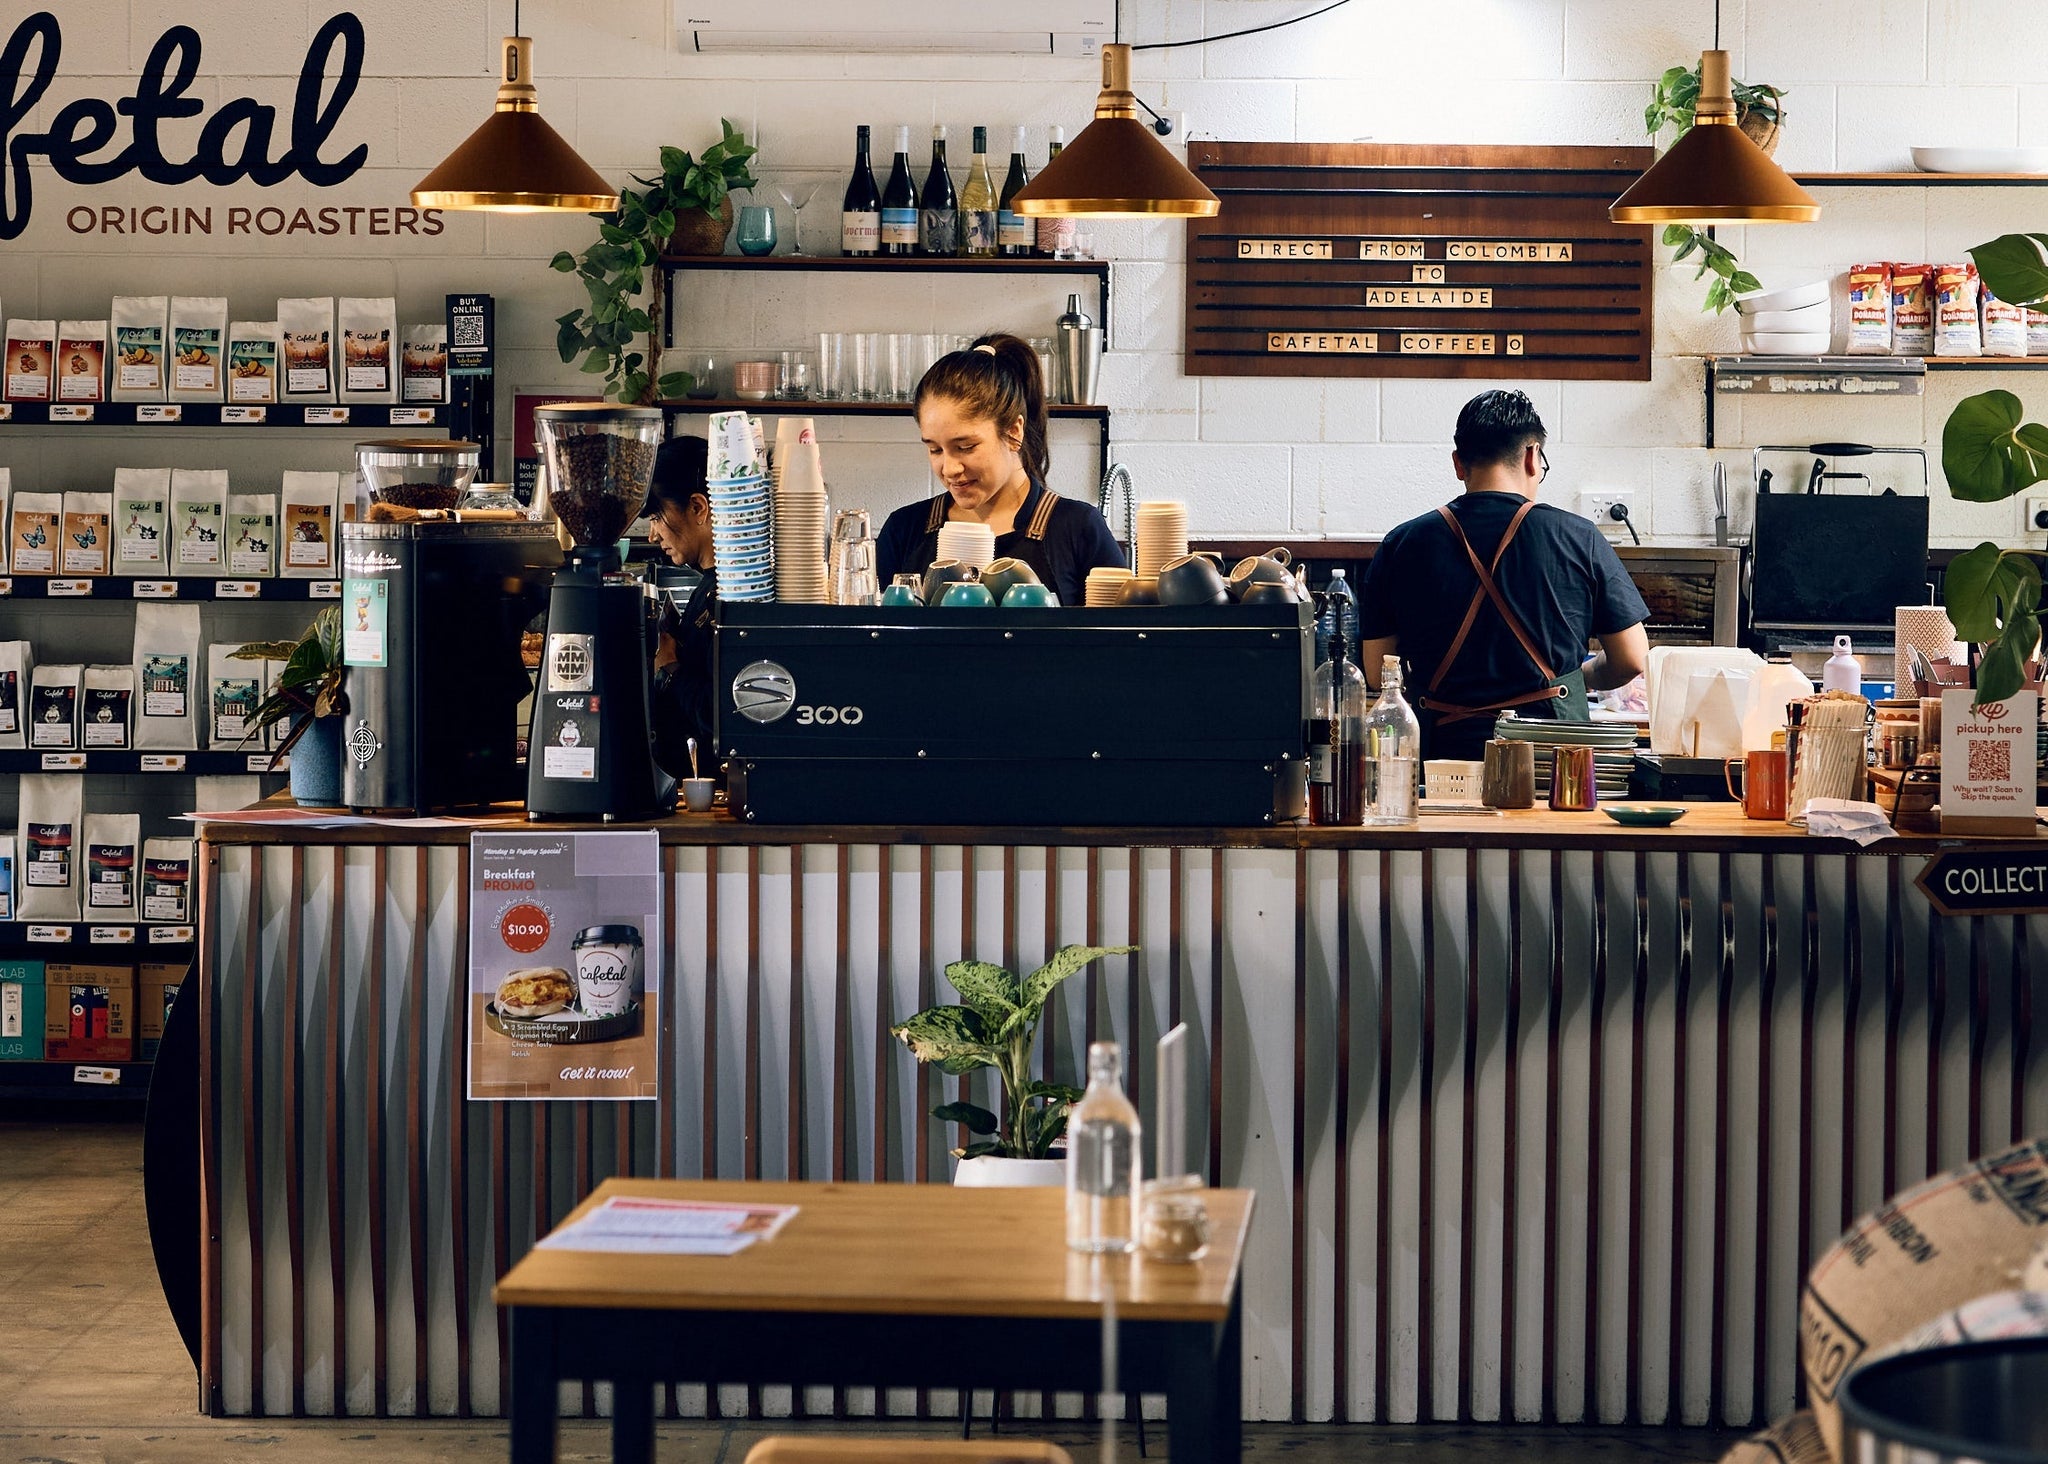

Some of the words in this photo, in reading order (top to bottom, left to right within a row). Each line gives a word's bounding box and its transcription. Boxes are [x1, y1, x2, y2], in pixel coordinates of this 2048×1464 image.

[67, 206, 211, 235] ORIGIN
[228, 206, 445, 236] ROASTERS
[1239, 242, 1331, 257] DIRECT
[1363, 242, 1425, 258] FROM
[1449, 243, 1570, 260] COLOMBIA
[1415, 266, 1443, 281] TO
[1368, 290, 1491, 305] ADELAIDE
[1270, 335, 1375, 350] CAFETAL
[1403, 336, 1492, 351] COFFEE
[556, 698, 585, 710] Cafetal
[796, 705, 864, 726] 300
[1956, 723, 1995, 736] pickup
[1997, 724, 2023, 734] here
[1952, 785, 1971, 794] Why
[1972, 785, 1993, 793] wait?
[1994, 785, 2014, 793] Scan
[1960, 793, 1978, 801] Skip
[1978, 793, 1991, 801] the
[1991, 794, 2017, 802] queue.
[483, 868, 536, 880] Breakfast
[1945, 866, 2048, 895] COLLECT
[483, 880, 536, 891] PROMO
[490, 915, 501, 929] Egg
[525, 895, 545, 908] Small
[507, 923, 543, 936] $10.90
[580, 964, 628, 986] Cafetal
[517, 1023, 551, 1031] Scrambled
[552, 1024, 569, 1032] Eggs
[536, 1041, 553, 1049] Tasty
[559, 1067, 584, 1080] Get
[584, 1066, 596, 1079] it
[596, 1066, 635, 1079] now!
